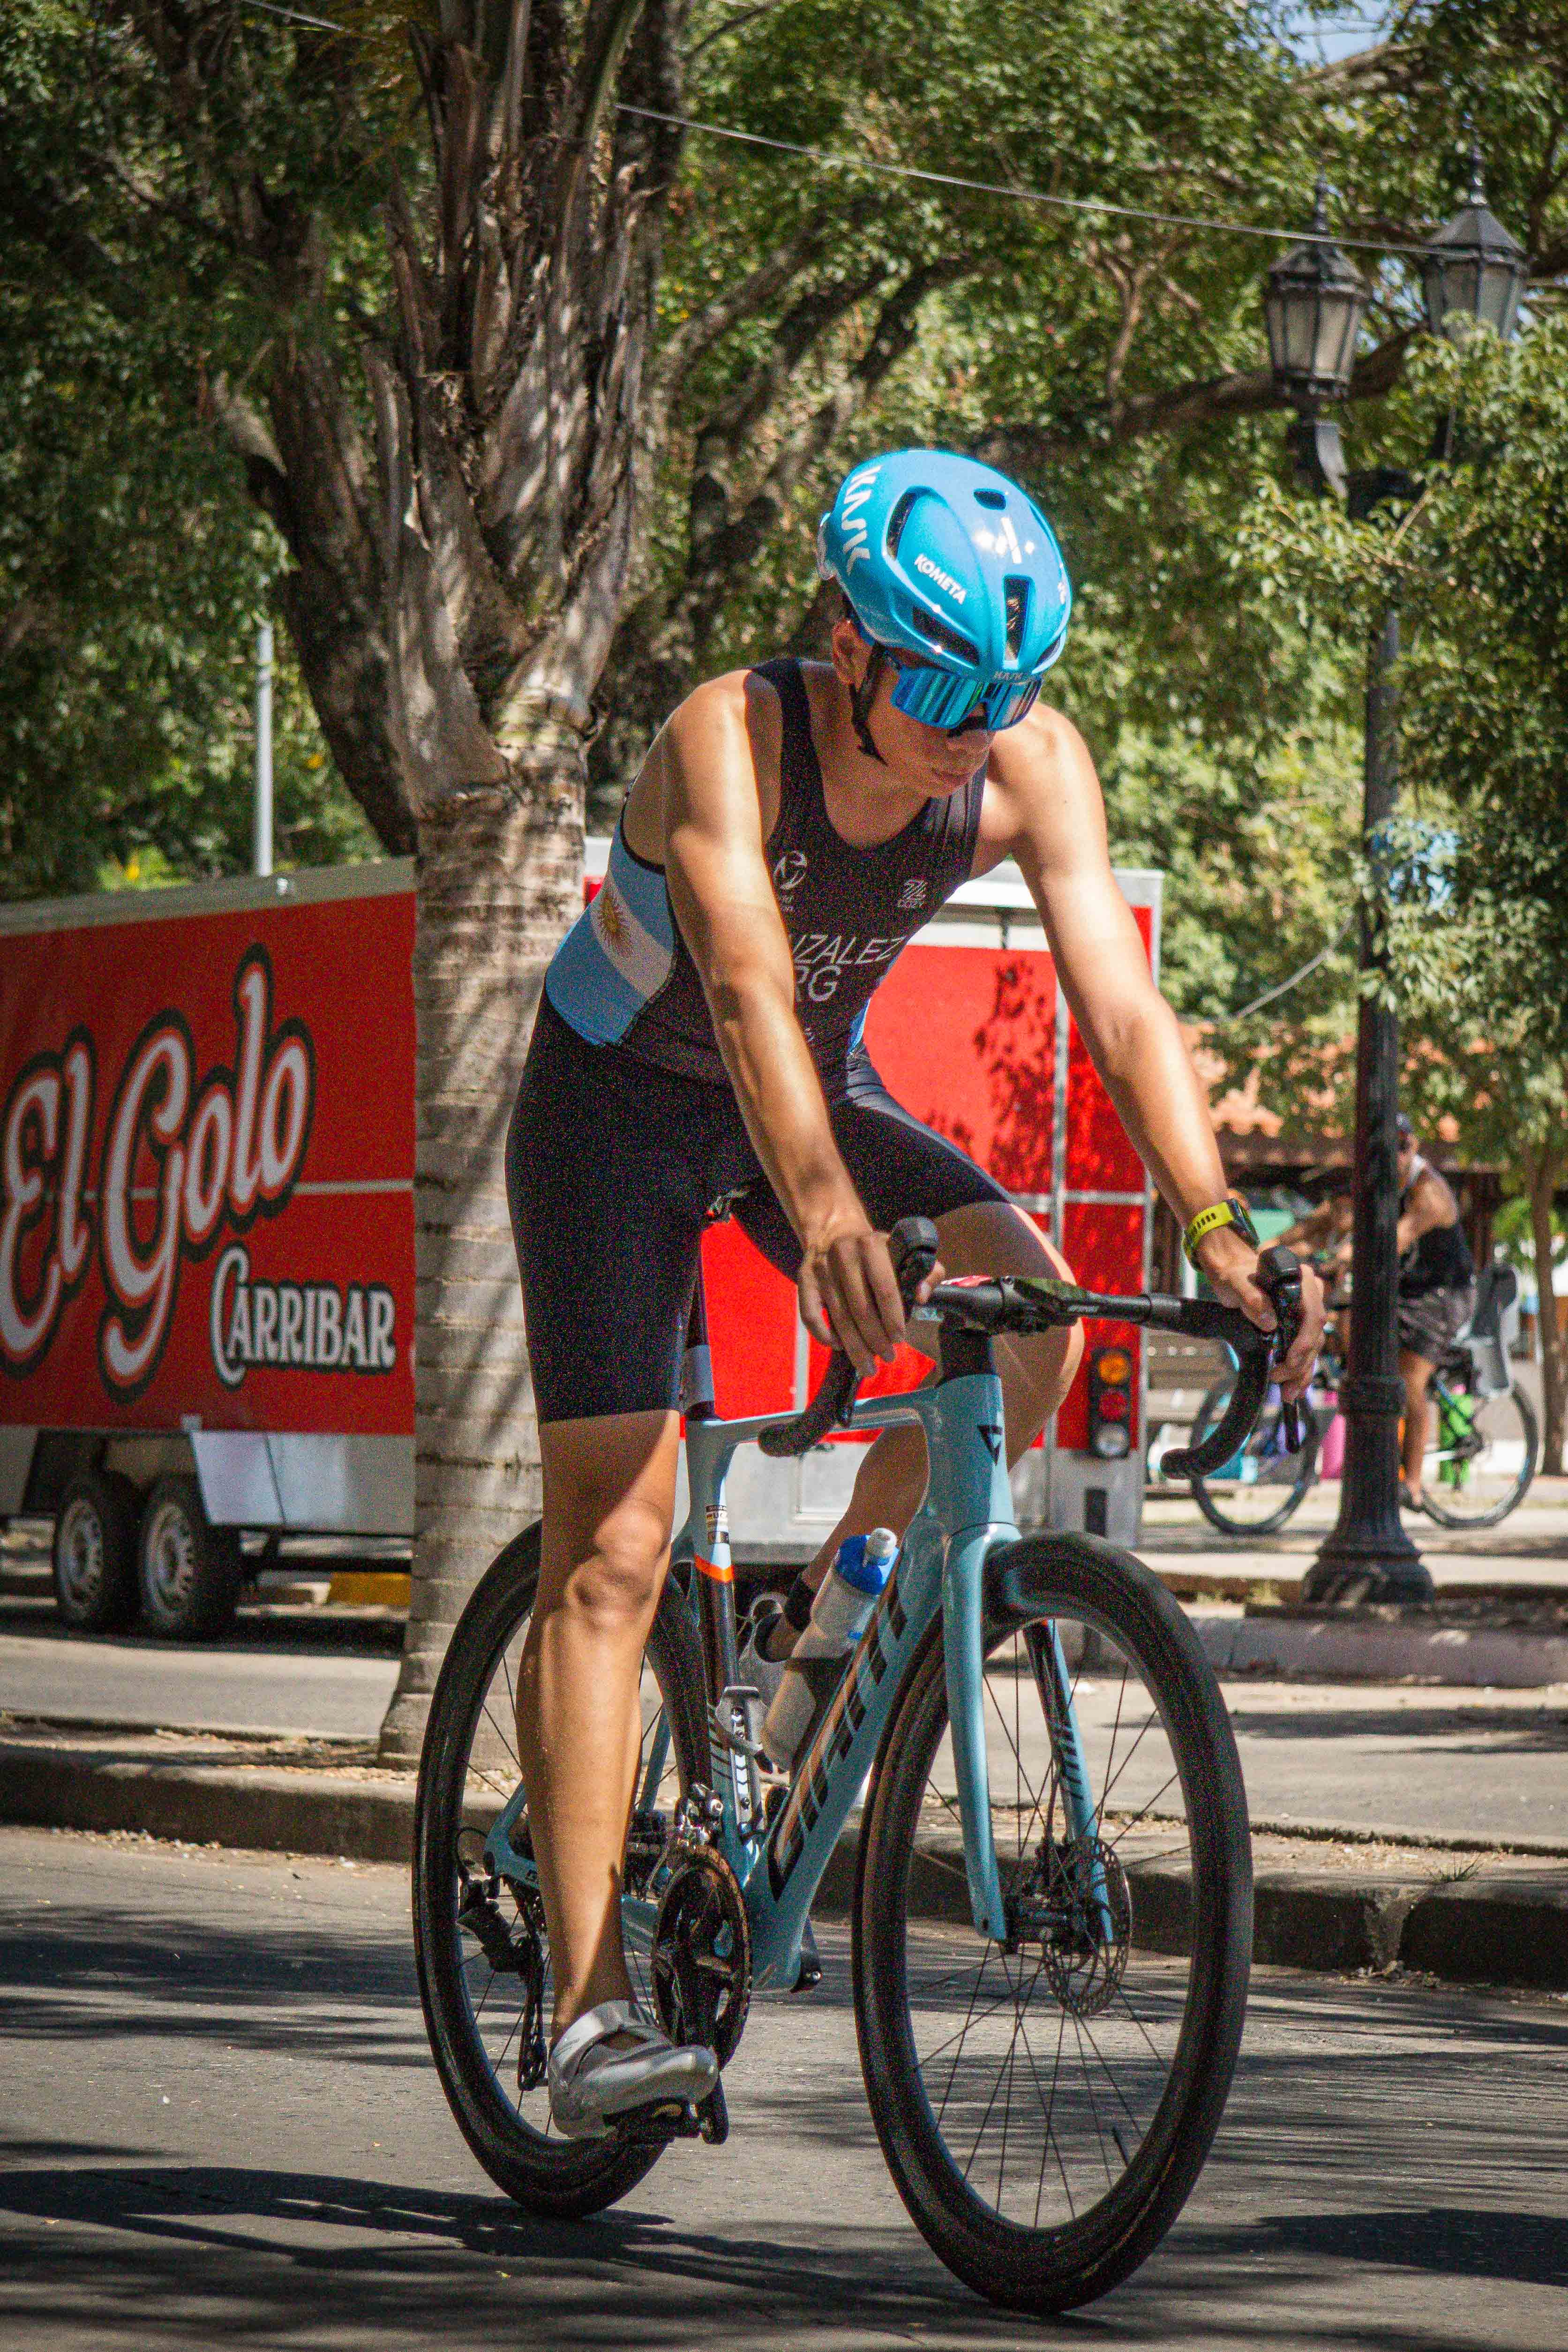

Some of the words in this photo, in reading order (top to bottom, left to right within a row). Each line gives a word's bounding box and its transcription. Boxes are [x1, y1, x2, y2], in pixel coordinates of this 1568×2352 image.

[914, 553, 968, 605] KOMETA
[790, 934, 908, 965] ZALEZ
[0, 1035, 92, 1357] El
[101, 961, 311, 1385] Golo
